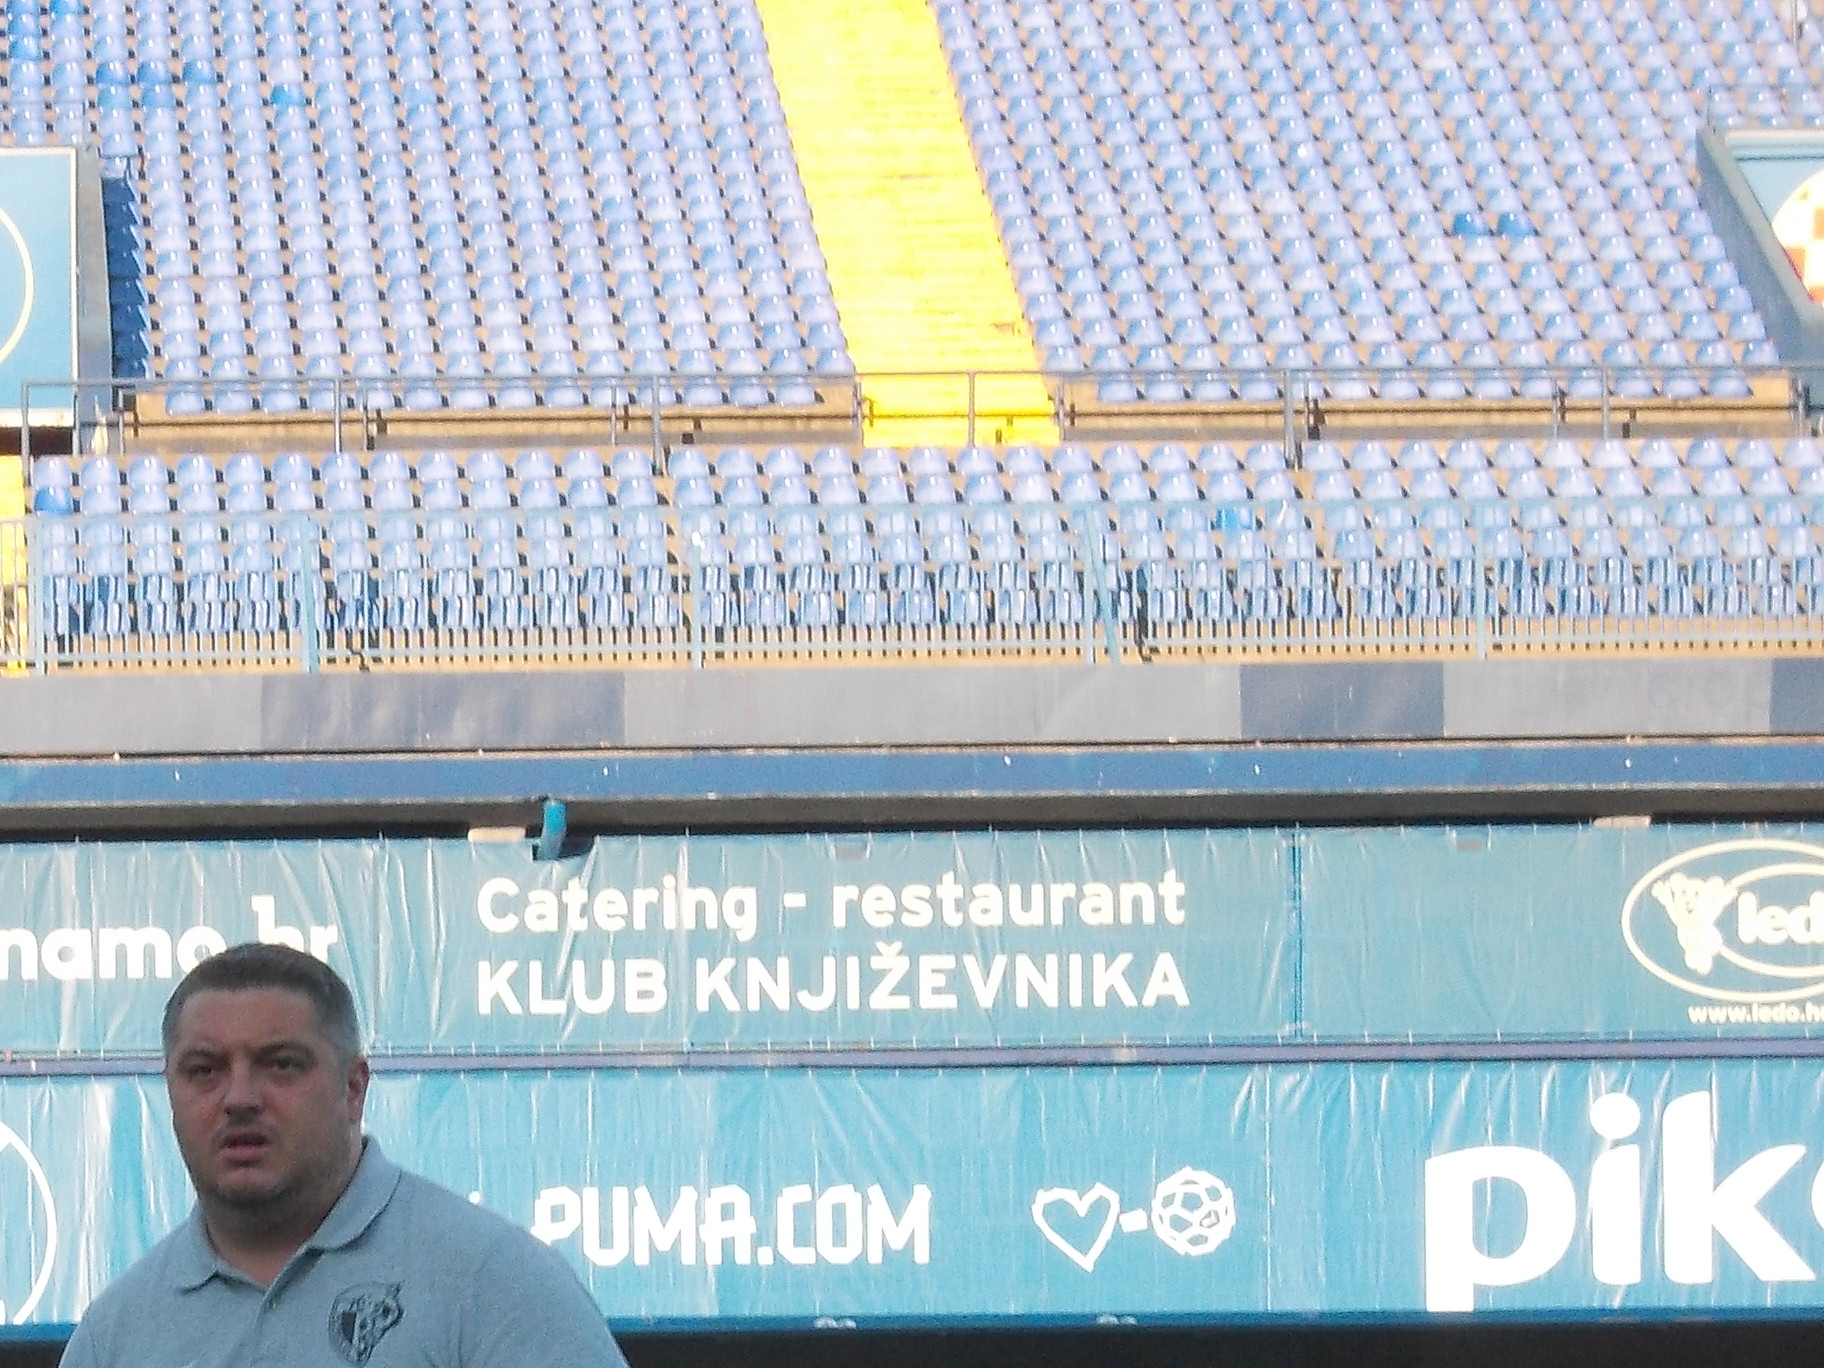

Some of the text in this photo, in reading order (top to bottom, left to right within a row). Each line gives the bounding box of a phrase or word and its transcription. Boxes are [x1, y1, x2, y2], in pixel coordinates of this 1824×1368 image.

[477, 873, 758, 943] Catering
[833, 869, 1188, 929] restaurant
[477, 941, 1191, 1016] KLUB KNJIŽEVNIKA
[1688, 1001, 1824, 1024] www.ledo.h
[530, 1183, 933, 1266] PUMA.COM
[1424, 1091, 1824, 1313] pik
